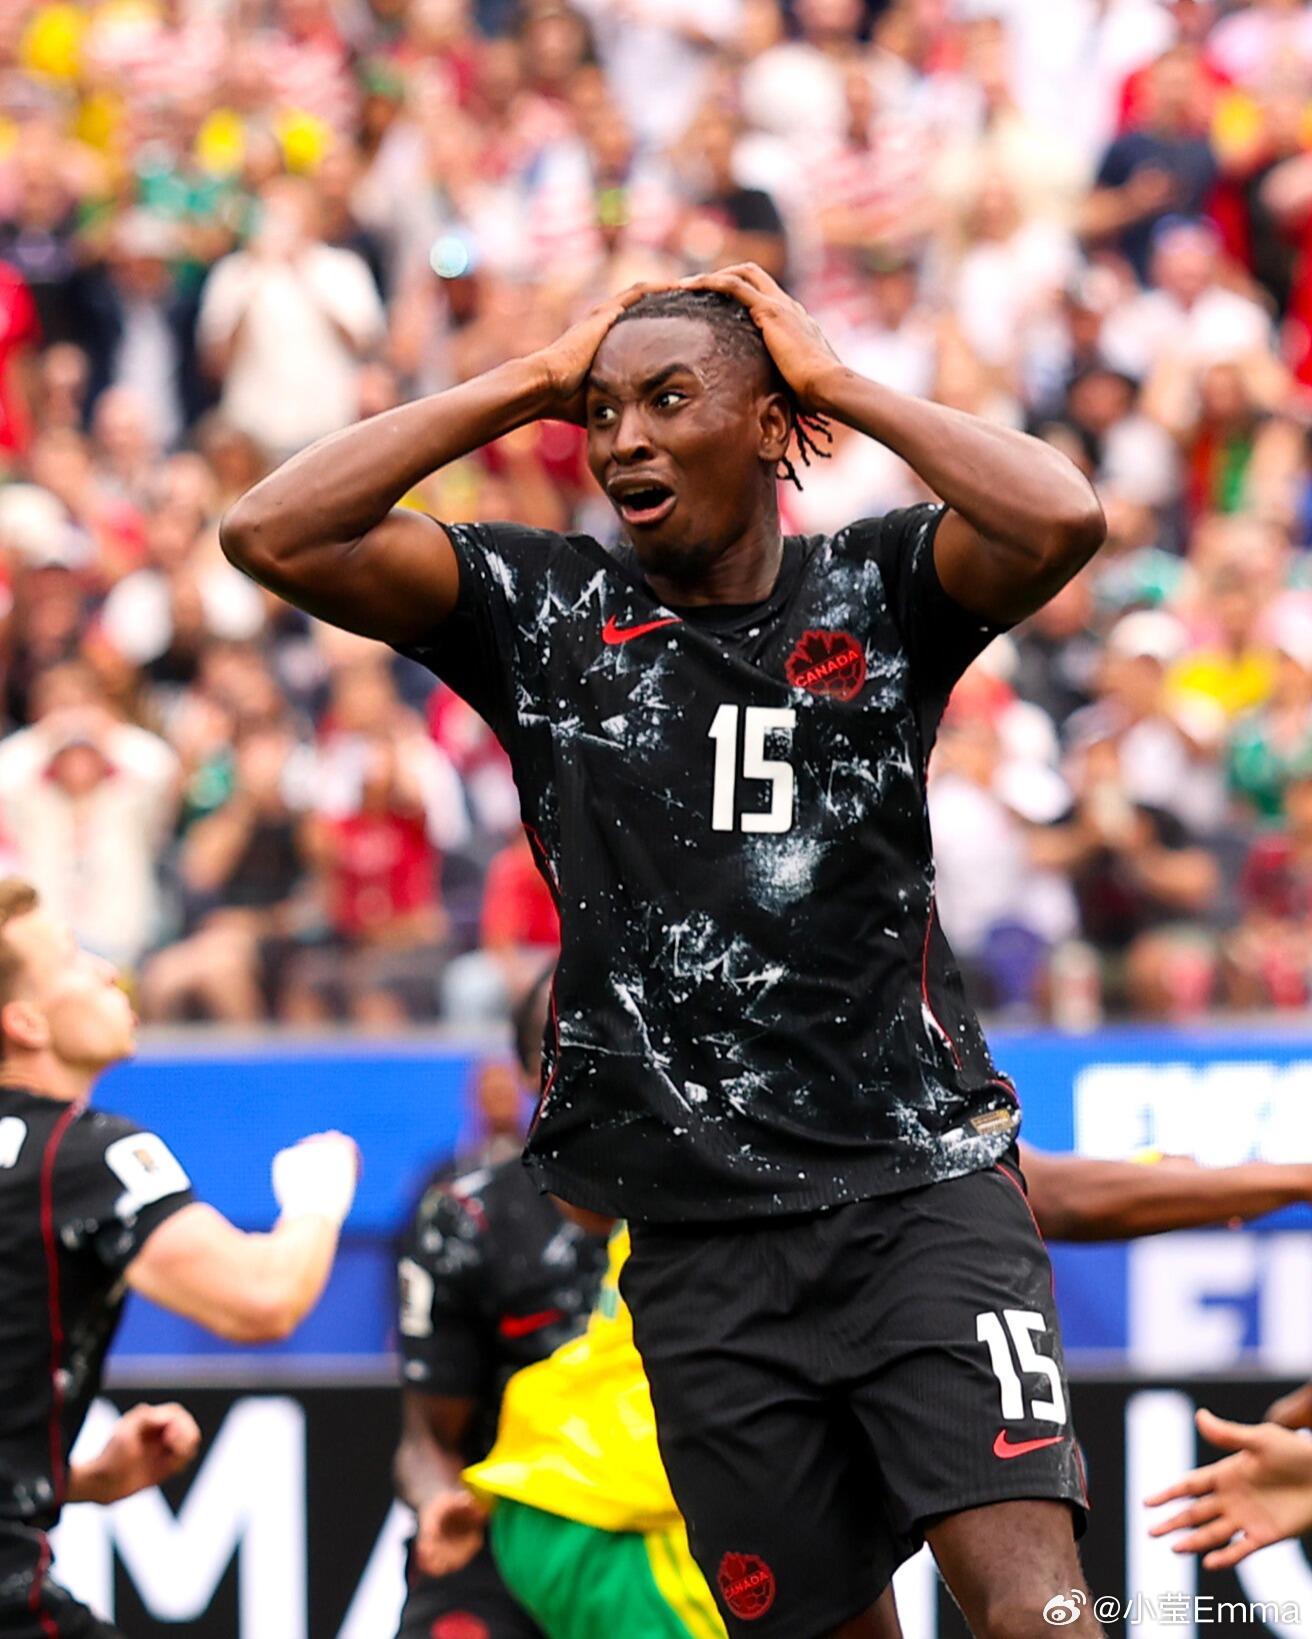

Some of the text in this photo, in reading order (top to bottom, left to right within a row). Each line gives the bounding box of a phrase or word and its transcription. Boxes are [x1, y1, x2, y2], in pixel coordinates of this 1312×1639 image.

[795, 650, 859, 687] CANADA
[708, 704, 796, 834] 15
[976, 1309, 1066, 1425] 15
